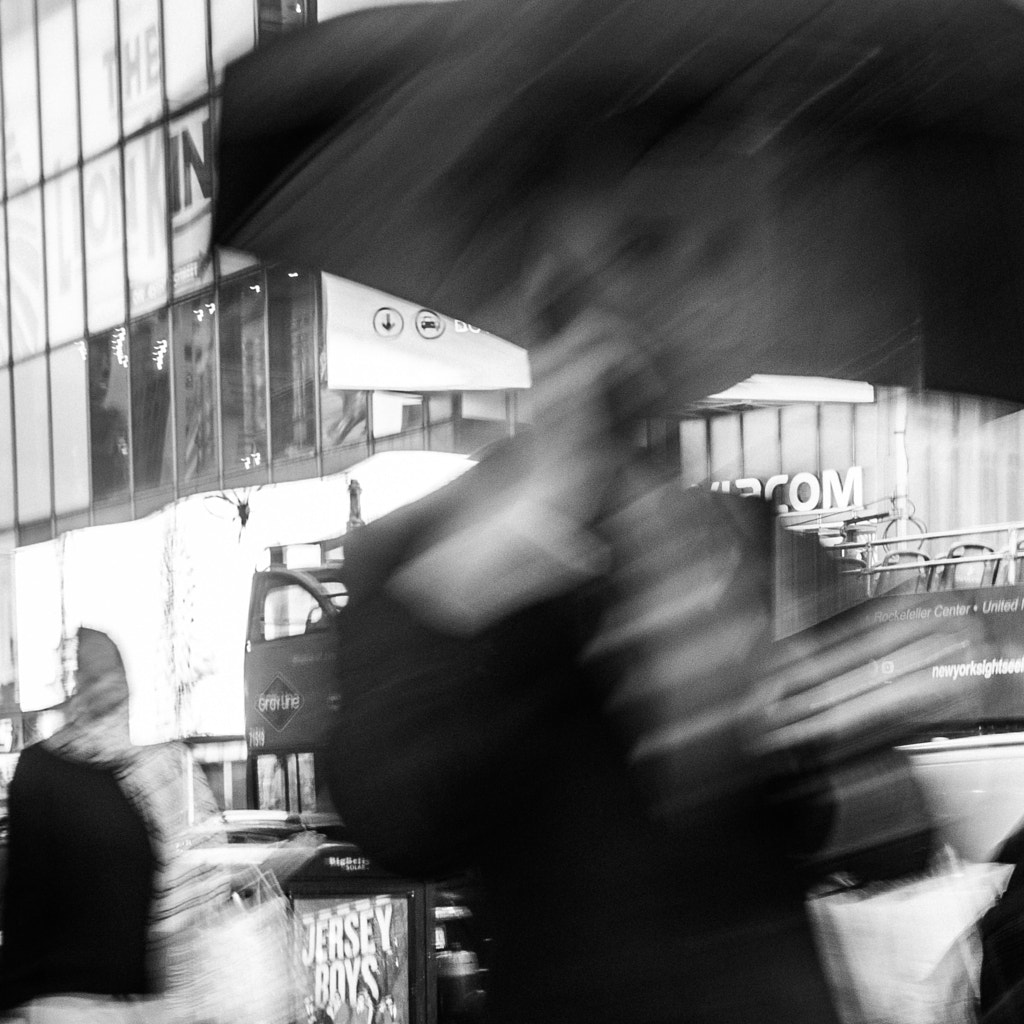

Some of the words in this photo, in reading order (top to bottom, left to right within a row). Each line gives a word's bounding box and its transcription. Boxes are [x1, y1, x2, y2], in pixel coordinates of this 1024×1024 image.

[933, 601, 970, 619] Center
[981, 598, 1018, 615] United
[302, 902, 393, 964] JERSEY
[315, 954, 380, 1011] BOYS
